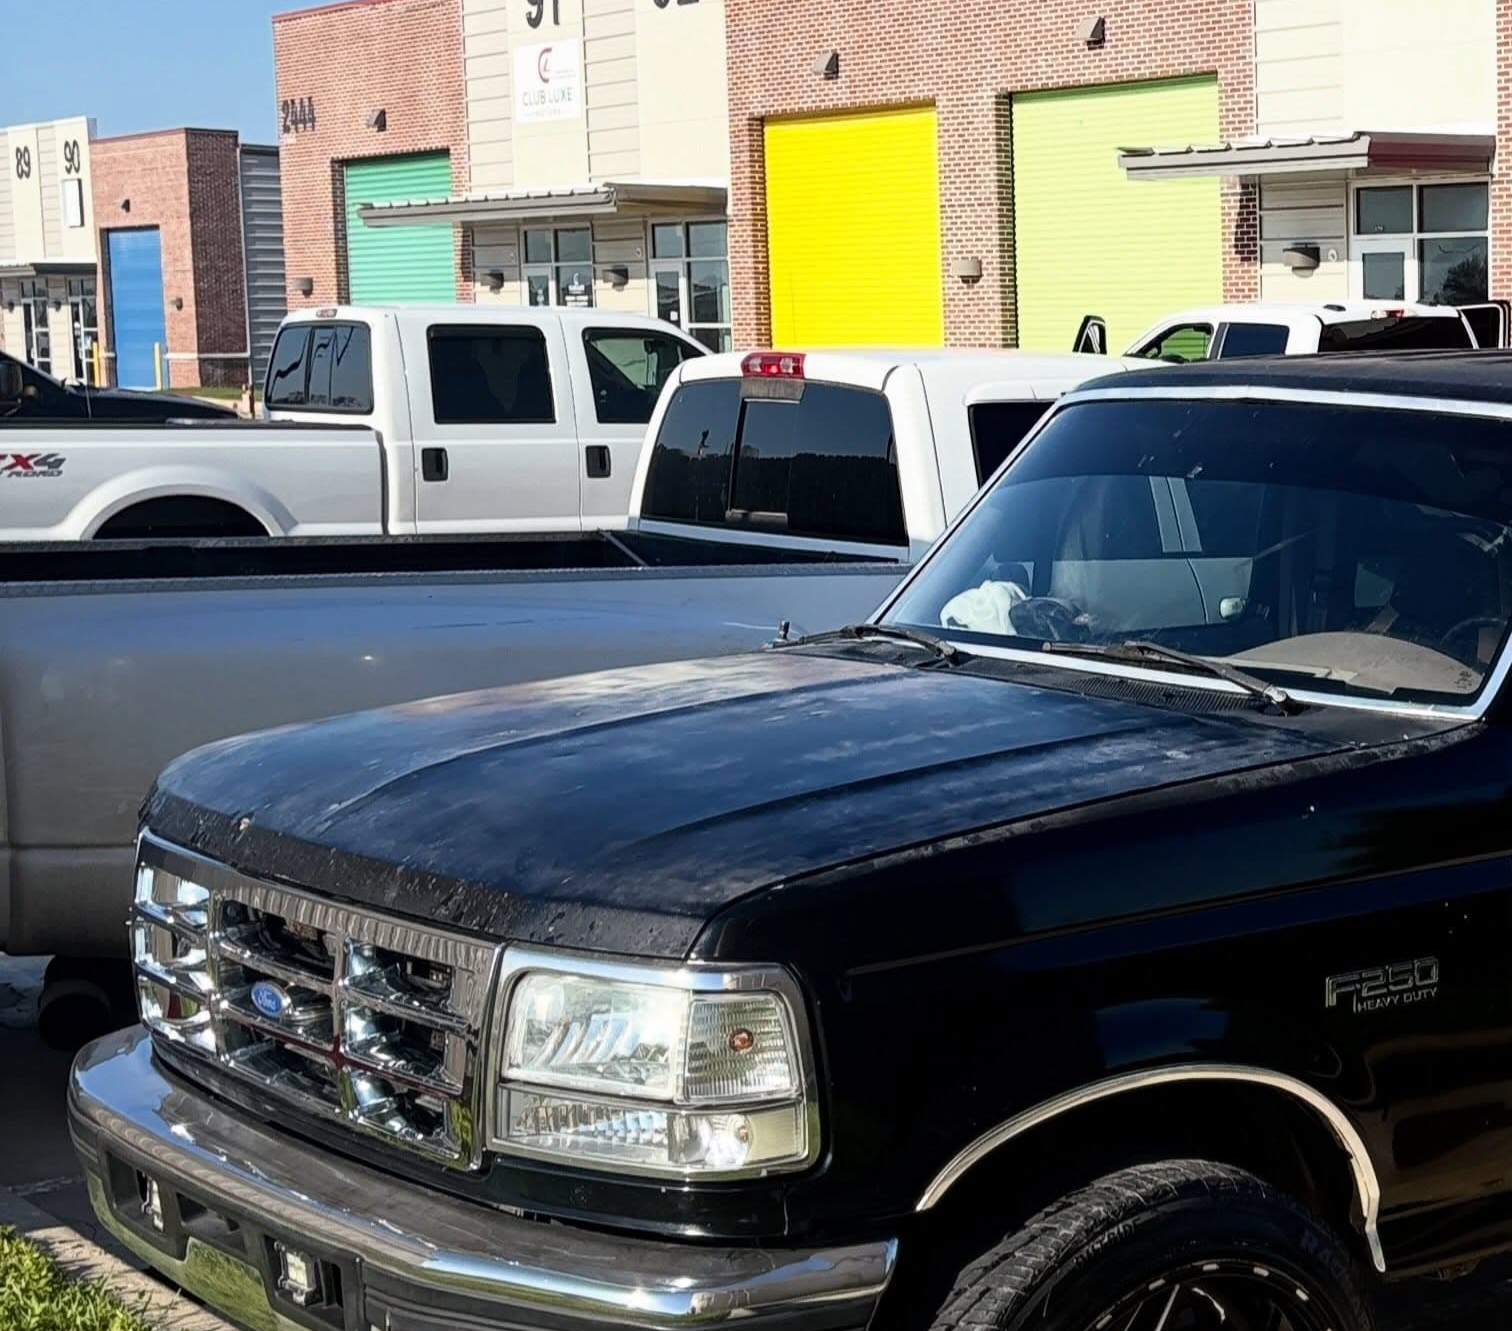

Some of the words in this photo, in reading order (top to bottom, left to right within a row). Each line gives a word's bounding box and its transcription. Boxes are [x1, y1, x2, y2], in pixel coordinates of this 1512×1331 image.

[522, 89, 546, 107] CLUB
[548, 86, 573, 103] LUXE
[282, 96, 316, 134] 2444
[15, 145, 31, 180] 89
[63, 139, 80, 175] 90
[1358, 995, 1400, 1012] HEAVY
[1403, 987, 1438, 1004] DUTY
